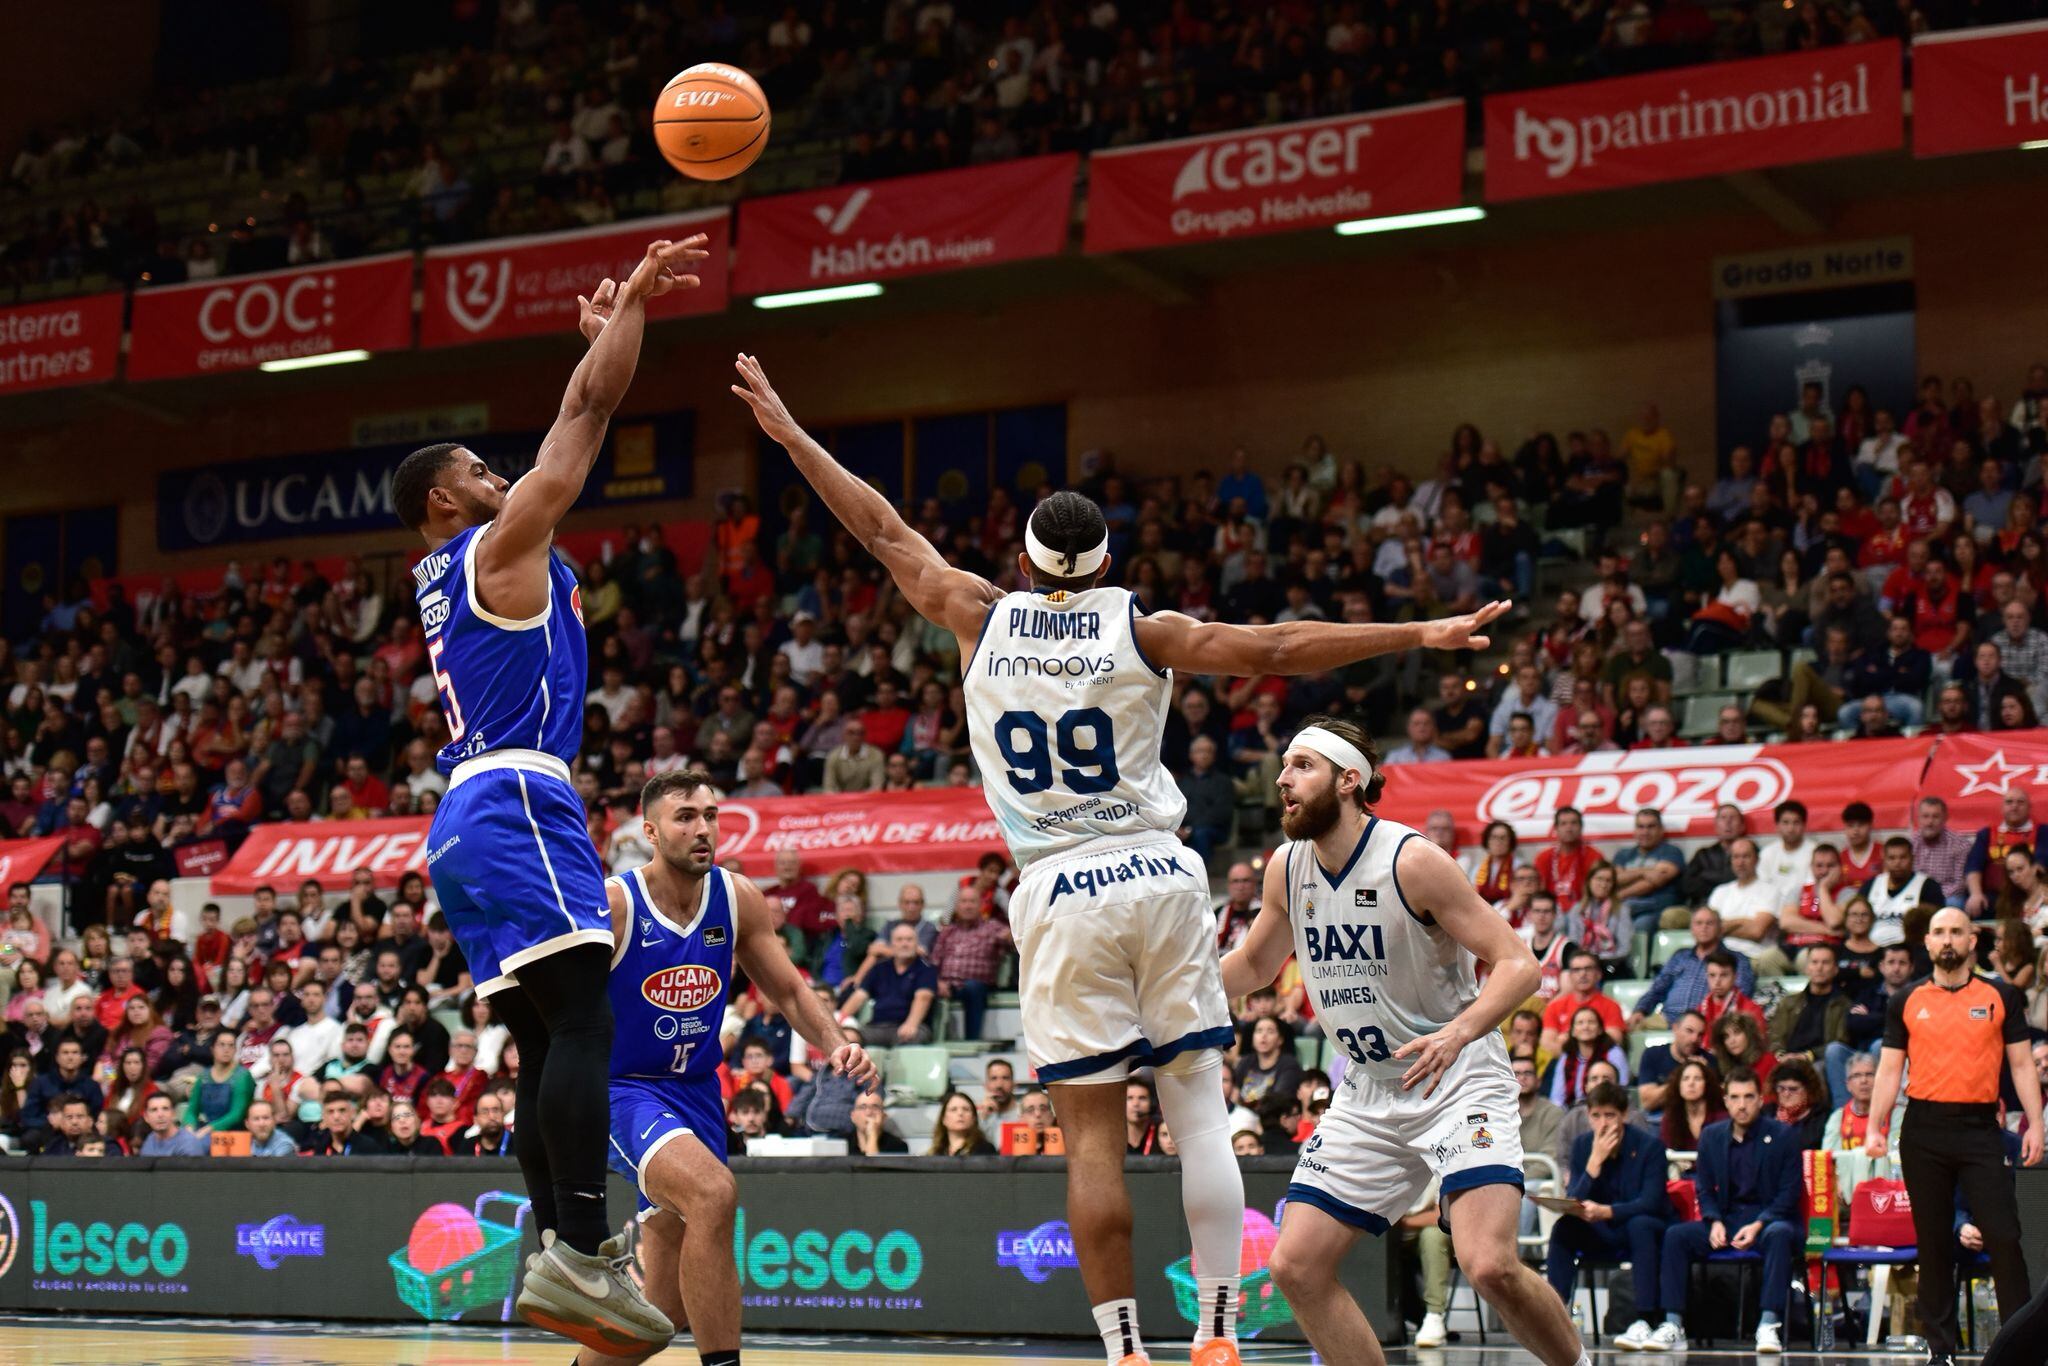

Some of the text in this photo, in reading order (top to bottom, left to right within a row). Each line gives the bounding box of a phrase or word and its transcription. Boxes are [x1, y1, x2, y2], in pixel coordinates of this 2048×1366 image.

[1212, 124, 1373, 190] caser
[1171, 186, 1371, 236] Grupo Helvetia
[810, 233, 995, 279] Halcón viajes
[1722, 247, 1905, 288] Grada Norte
[234, 465, 395, 528] UCAM
[1009, 607, 1100, 641] PLUMMER
[988, 651, 1115, 677] inmoovs
[428, 636, 465, 743] 5
[1065, 680, 1075, 690] by
[994, 706, 1121, 795] 99
[882, 822, 928, 843] DE
[929, 820, 1004, 842] MUR
[1304, 924, 1386, 962] BAXI
[650, 986, 716, 1008] MURCIA
[660, 968, 712, 988] UCAM
[670, 1042, 696, 1074] 15
[1336, 1025, 1391, 1065] 33
[30, 1200, 188, 1277] lesco
[237, 1229, 323, 1247] LEVANTE
[733, 1206, 923, 1292] lesco
[996, 1237, 1075, 1258] LEVAN
